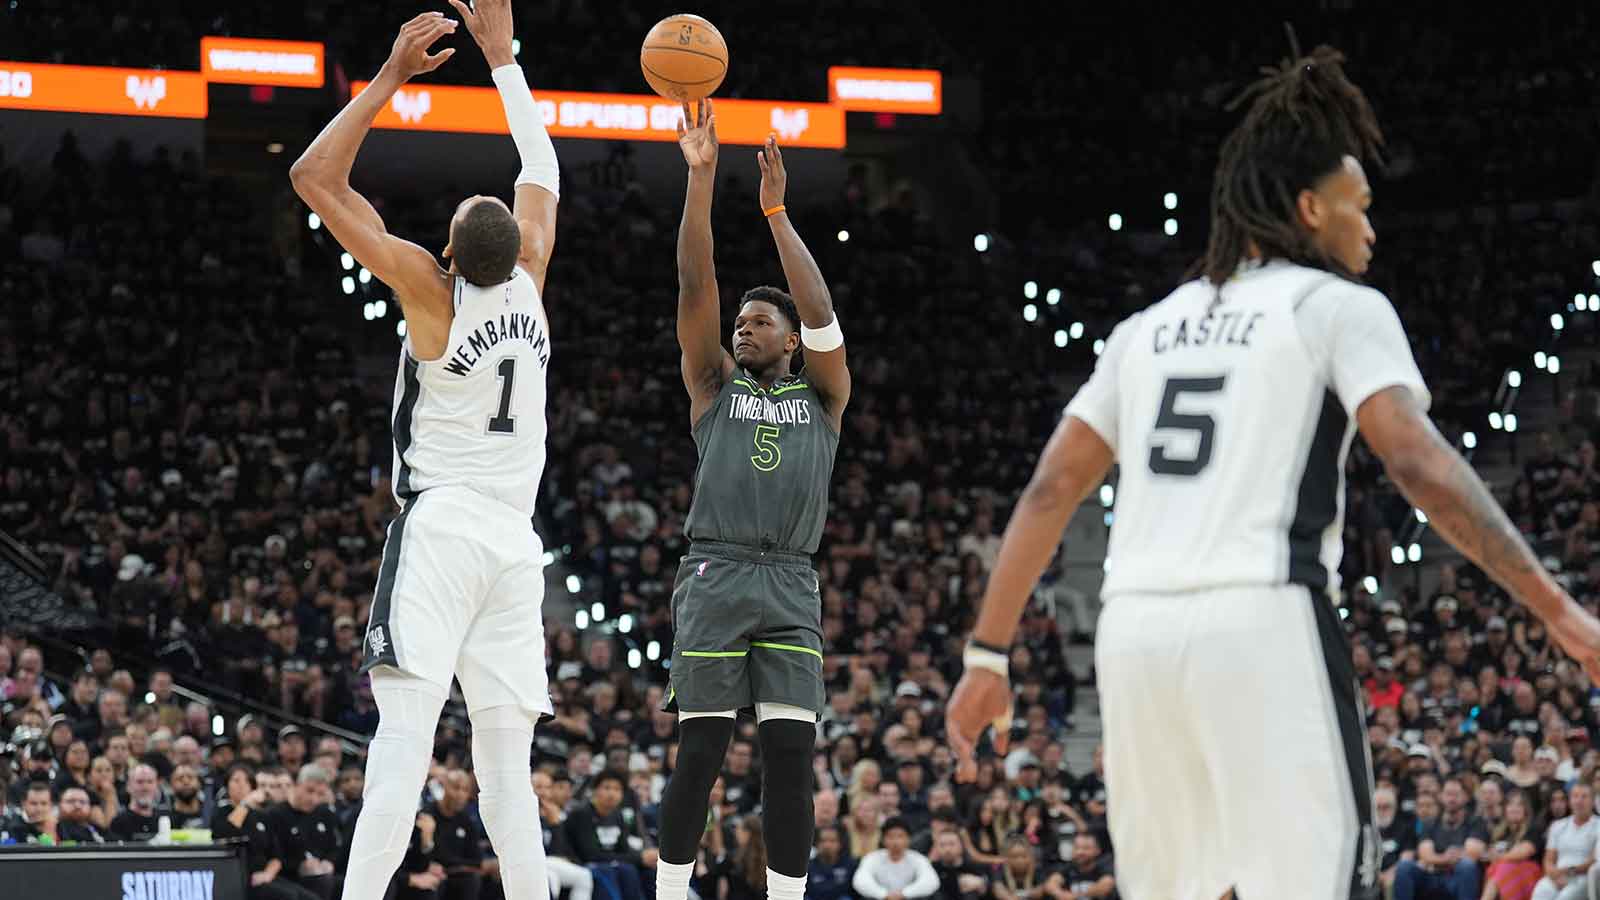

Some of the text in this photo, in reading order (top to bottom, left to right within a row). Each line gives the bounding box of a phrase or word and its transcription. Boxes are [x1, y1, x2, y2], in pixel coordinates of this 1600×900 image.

[559, 101, 648, 130] SPURS
[443, 312, 549, 377] WEMBANYAMA
[1153, 312, 1265, 353] CASTLE
[486, 356, 517, 435] 1
[728, 393, 811, 428] TIMBERWOLVES
[751, 424, 781, 472] 5
[1148, 375, 1227, 477] 5
[121, 870, 215, 900] SATURDAY
